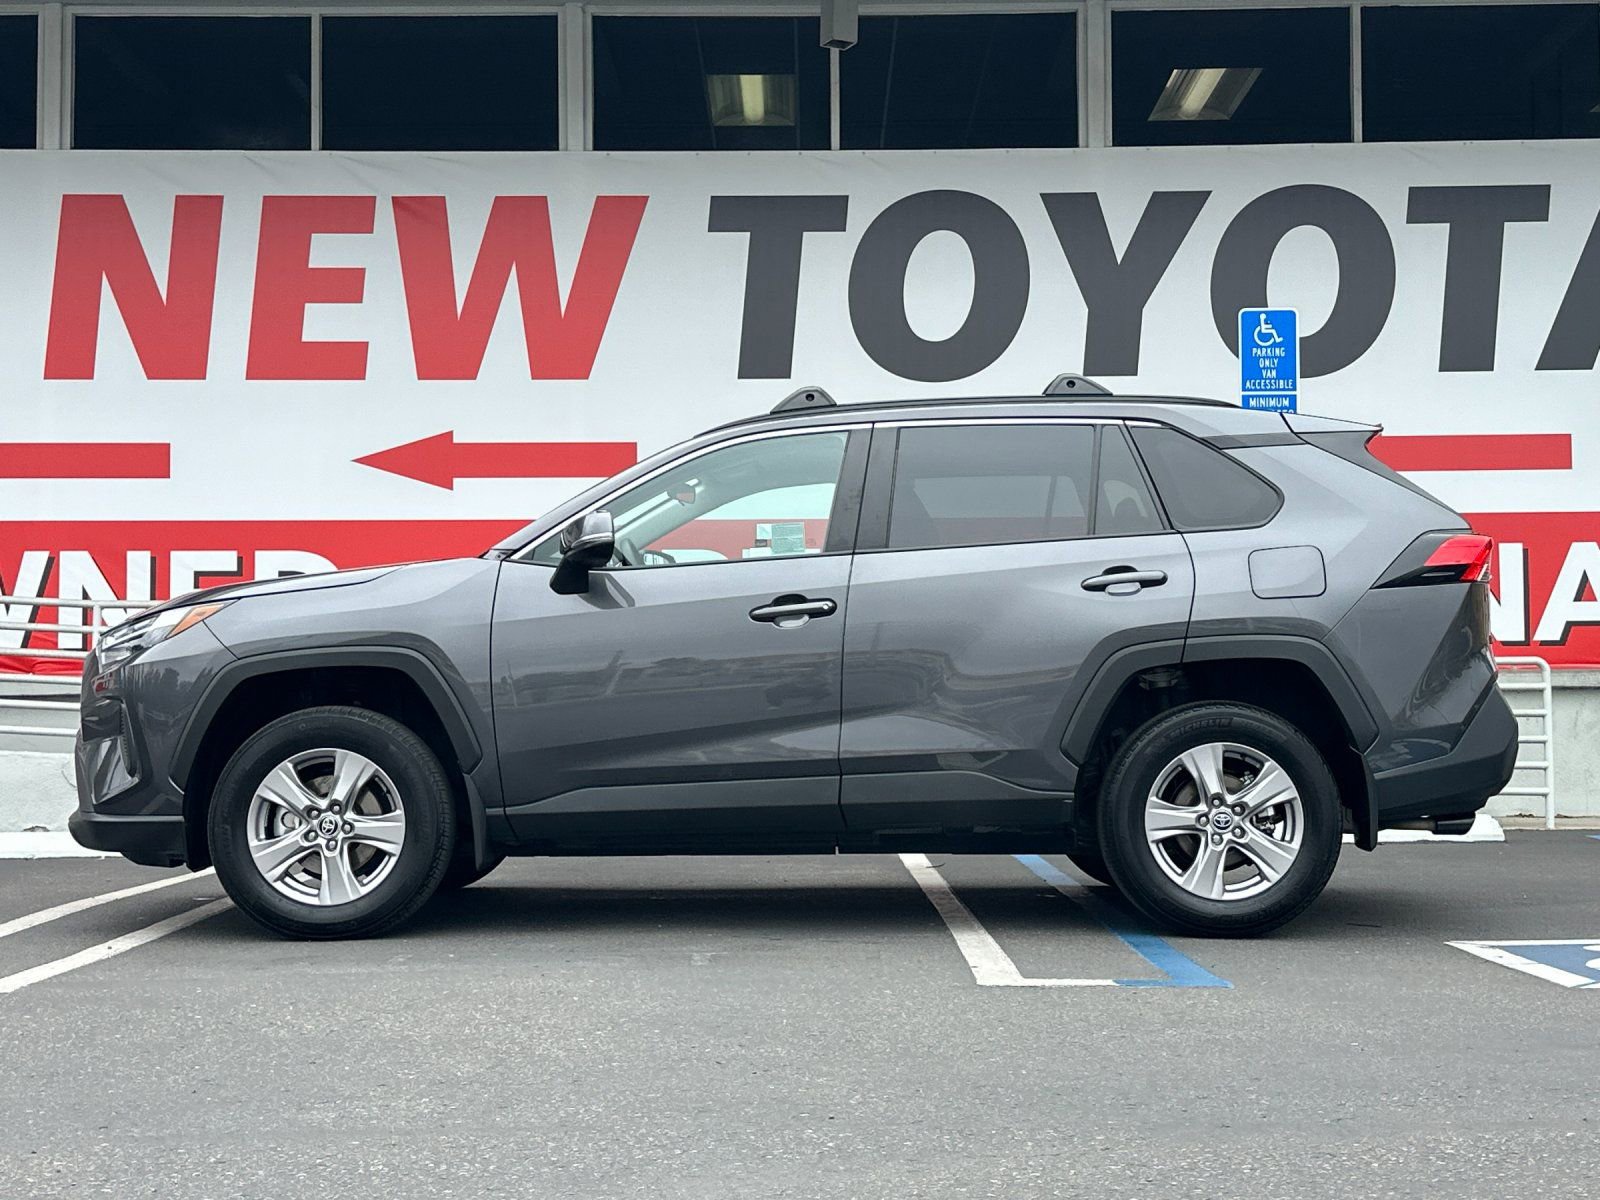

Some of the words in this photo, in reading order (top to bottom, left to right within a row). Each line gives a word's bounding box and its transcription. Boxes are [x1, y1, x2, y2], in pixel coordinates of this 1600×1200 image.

[44, 194, 650, 380] NEW
[1252, 347, 1286, 357] PARKING
[1259, 358, 1279, 368] ONLY
[1262, 369, 1277, 379] VAN
[1245, 379, 1294, 389] ACCESSIBLE
[1249, 397, 1290, 408] MINIMUM
